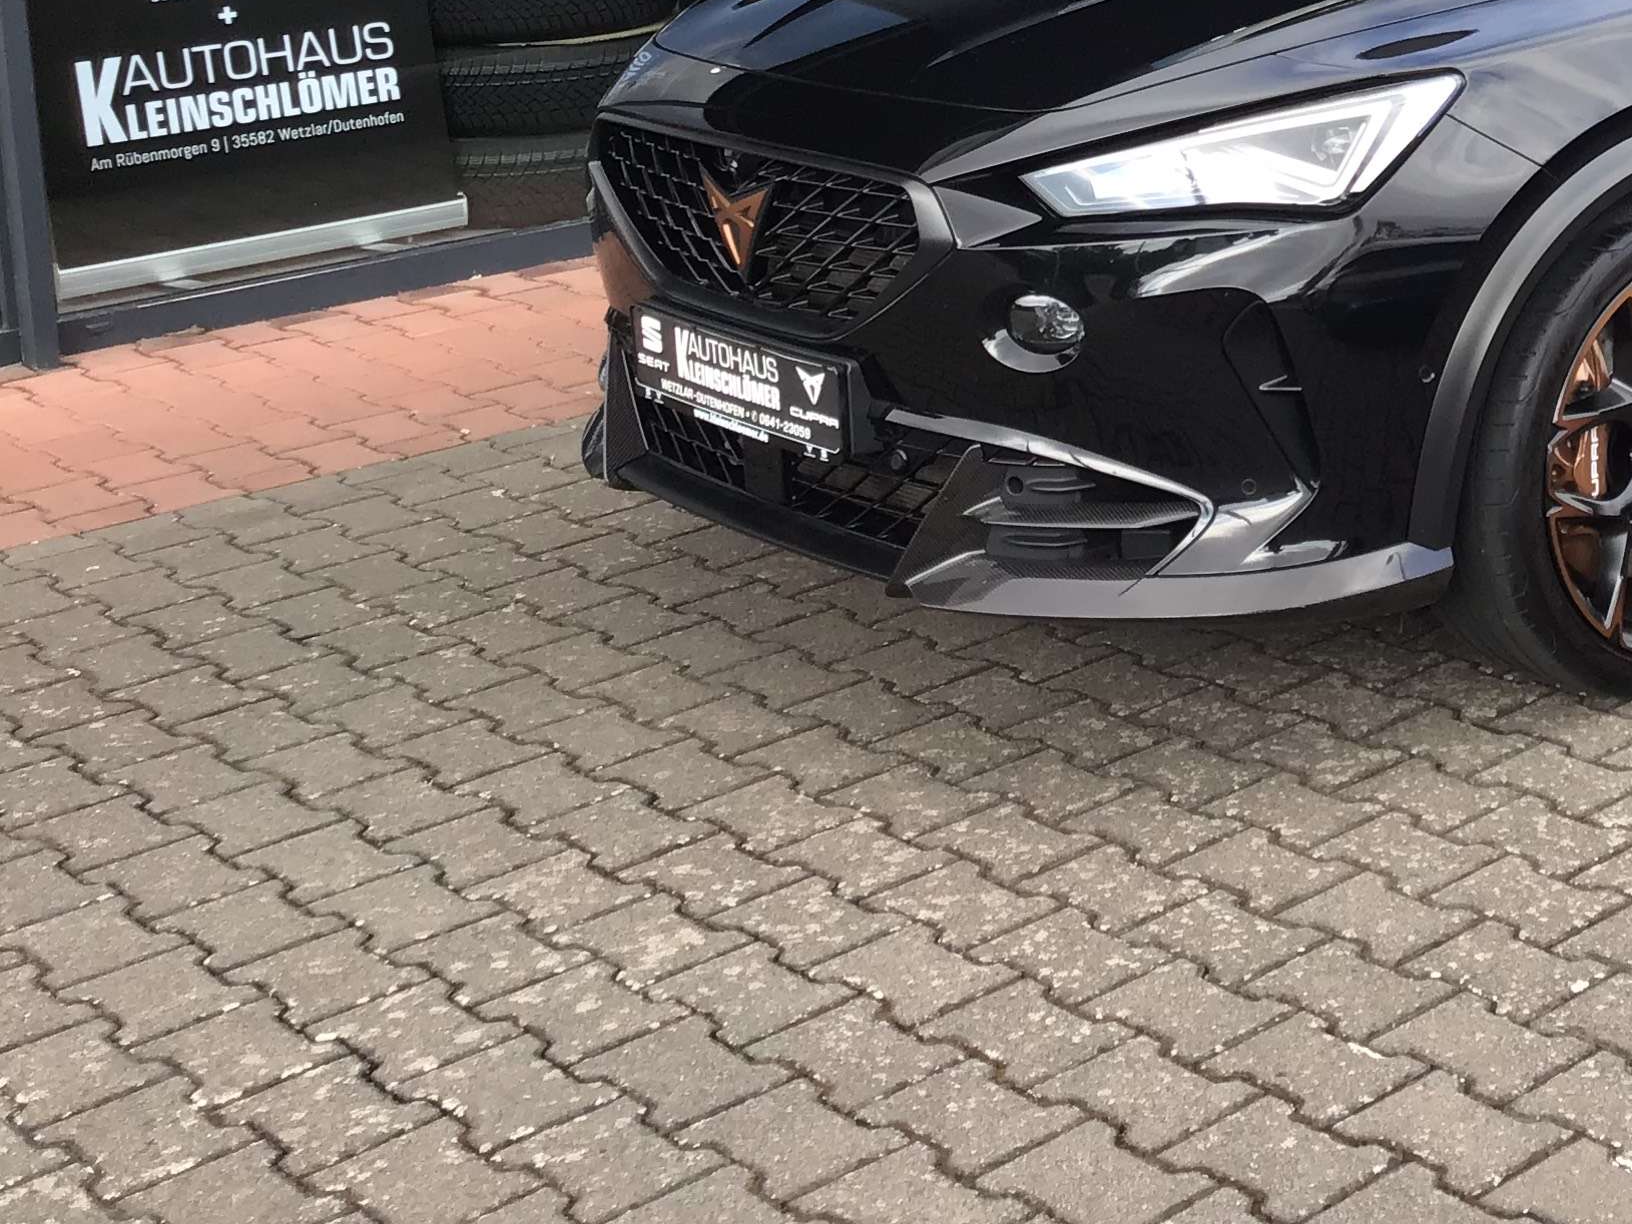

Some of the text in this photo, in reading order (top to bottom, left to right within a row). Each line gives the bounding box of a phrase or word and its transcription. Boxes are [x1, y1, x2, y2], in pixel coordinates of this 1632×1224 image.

[122, 21, 395, 97] AUTOHAUS
[75, 58, 401, 147] KLEINSCHLÖMER
[90, 110, 406, 173] Am Rübenmorgen 9 35582 Wetzlar/Dutenhofen
[637, 352, 670, 373] SEAT
[674, 326, 782, 411] KLEINSCHLÖMER
[688, 332, 780, 383] AUTOHAUS
[789, 404, 840, 430] CUPRA
